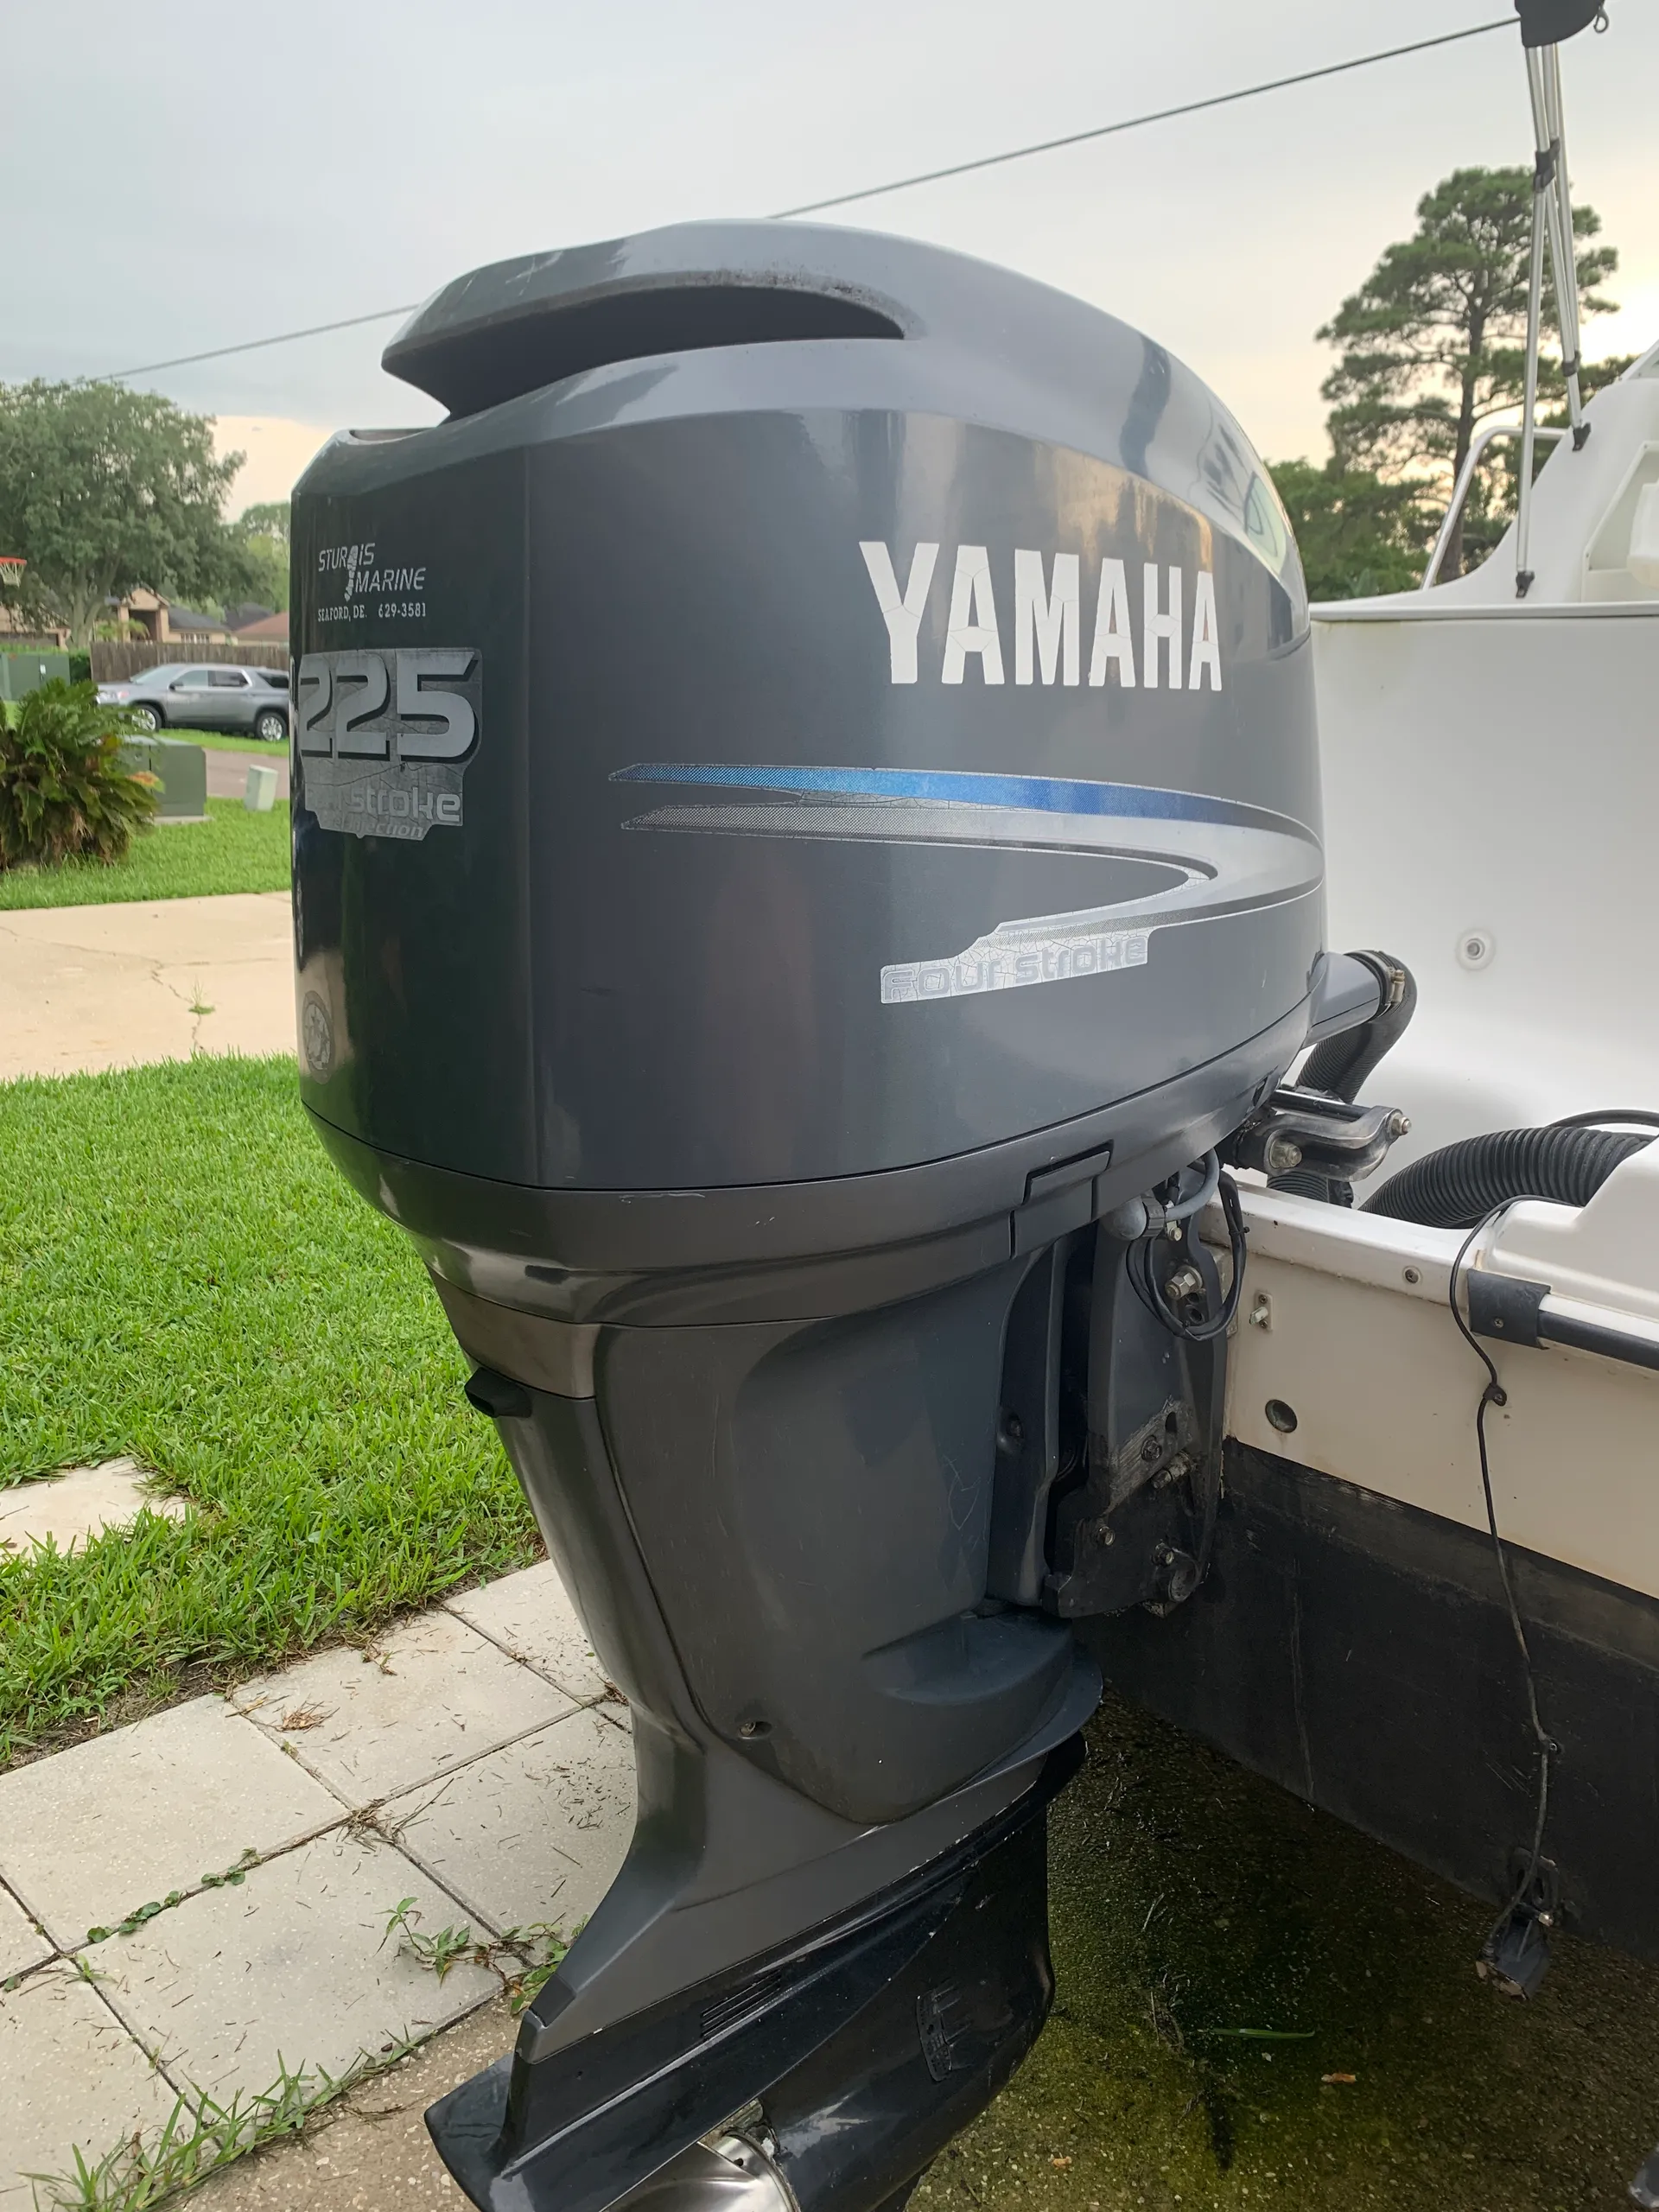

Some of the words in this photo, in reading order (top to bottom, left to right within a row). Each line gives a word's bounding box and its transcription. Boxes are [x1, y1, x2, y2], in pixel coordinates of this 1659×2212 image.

[318, 543, 376, 572] STURIS
[354, 567, 427, 594] MARINE
[317, 606, 352, 622] SEAFORD,
[353, 605, 368, 620] DE.
[378, 602, 427, 619] 629-3581
[859, 541, 1222, 691] YAMAHA
[300, 651, 480, 763] 225
